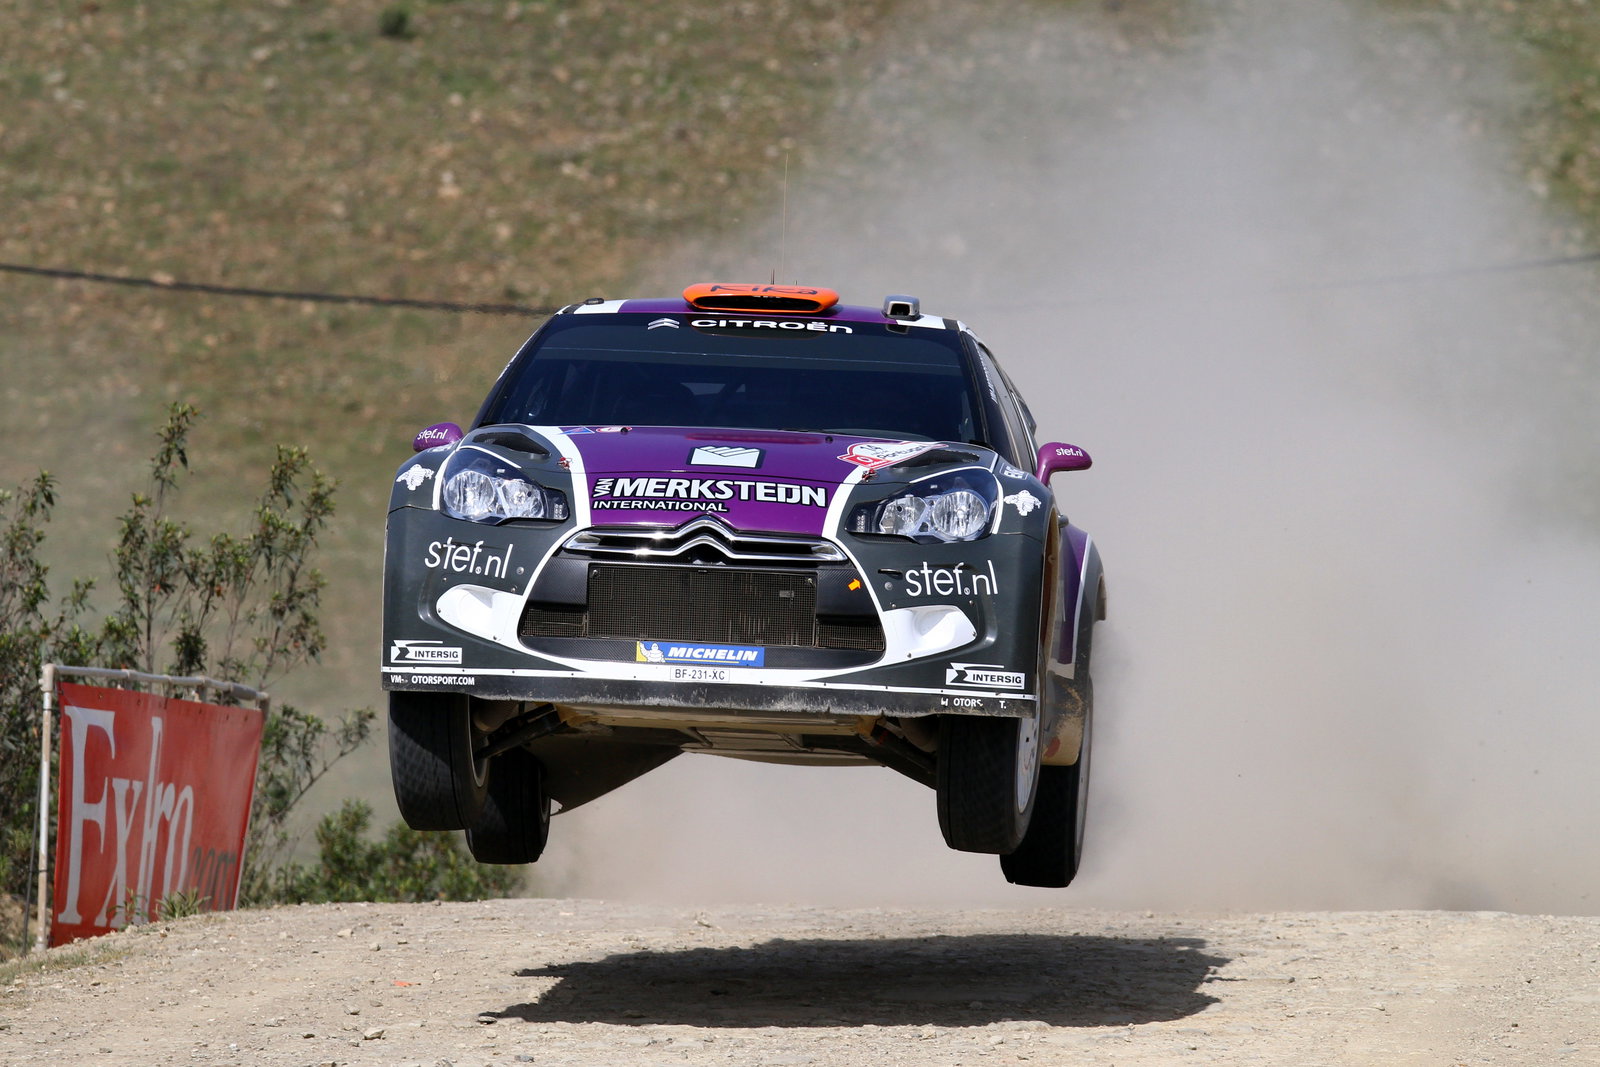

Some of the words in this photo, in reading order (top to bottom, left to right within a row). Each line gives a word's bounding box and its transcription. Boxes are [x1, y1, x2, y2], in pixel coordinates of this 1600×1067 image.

[417, 428, 449, 441] stef.nl
[593, 478, 615, 498] VAN
[592, 500, 728, 512] INTERNATIONAL
[424, 536, 514, 579] stef.nl
[905, 559, 999, 597] stef.nl
[414, 650, 459, 659] INTERSIG
[667, 646, 758, 661] MICHELIN
[674, 668, 726, 681] BF-231-XC
[972, 673, 1022, 684] INTERSIG
